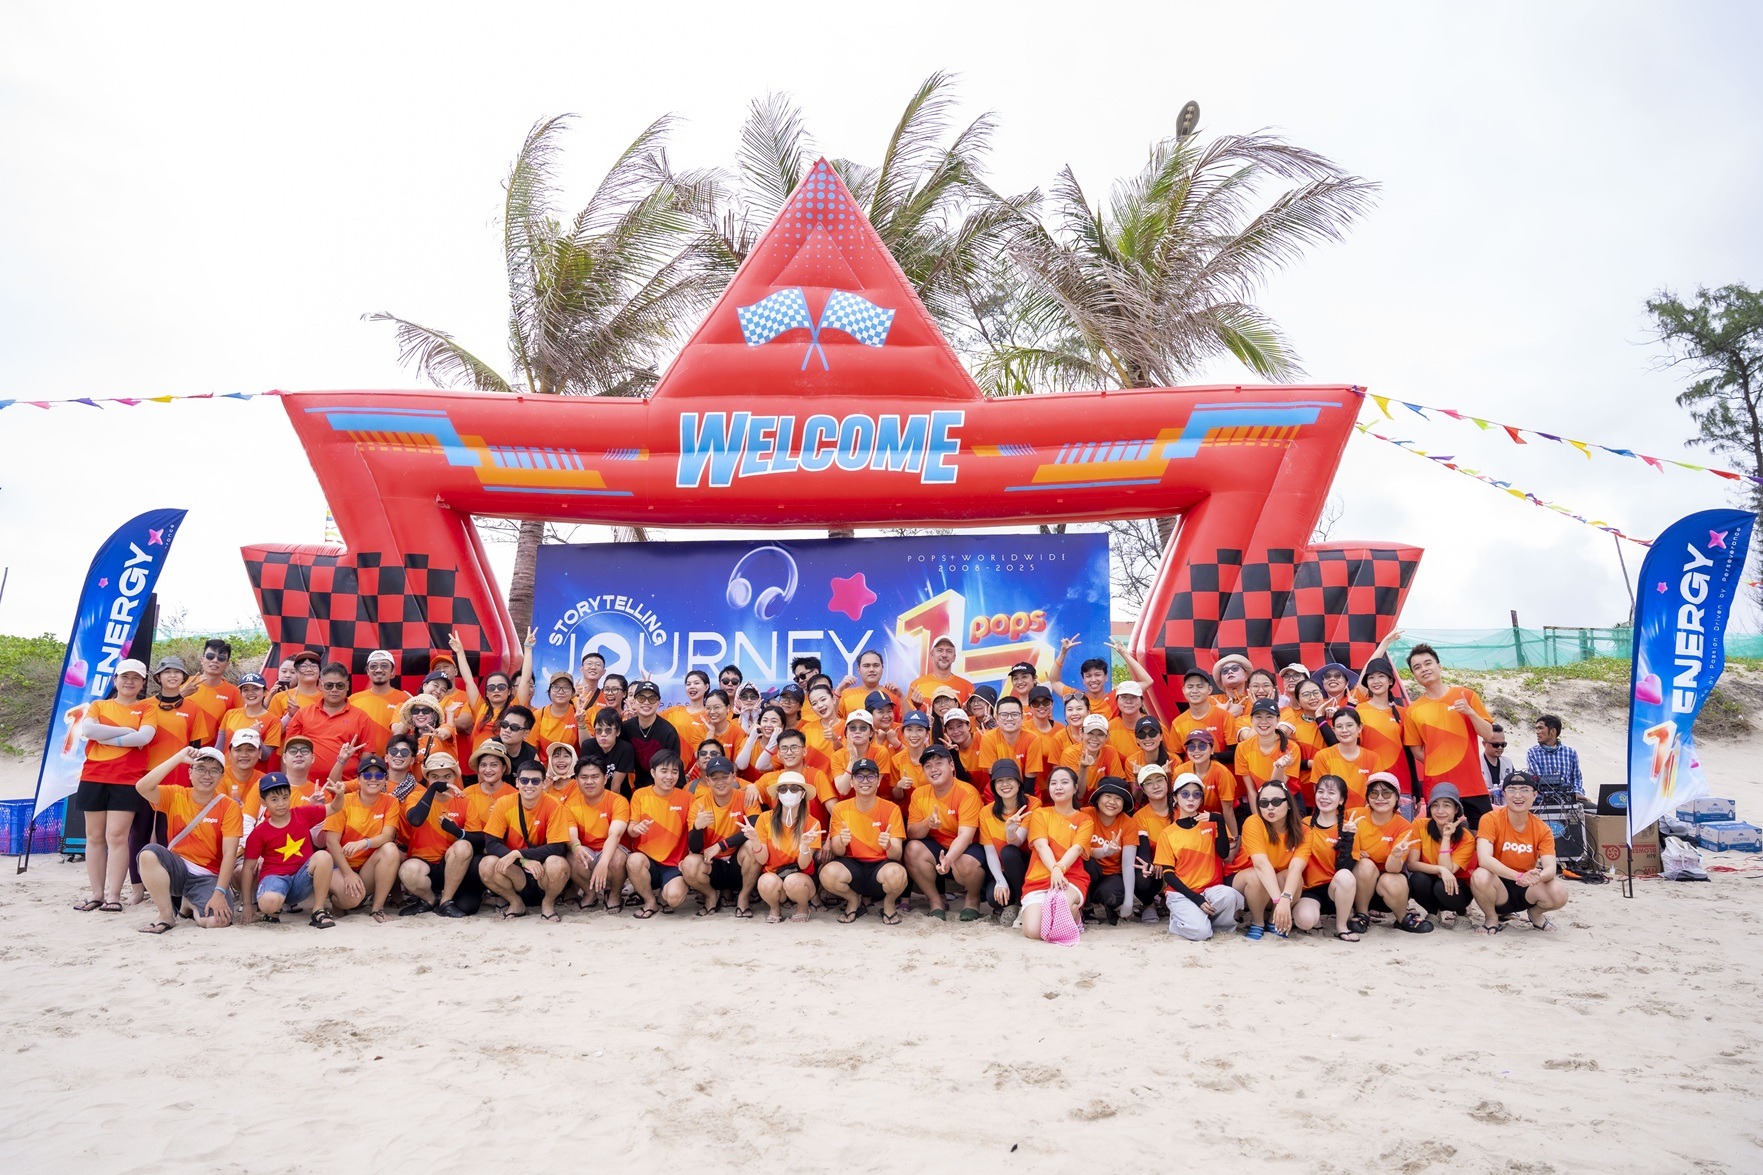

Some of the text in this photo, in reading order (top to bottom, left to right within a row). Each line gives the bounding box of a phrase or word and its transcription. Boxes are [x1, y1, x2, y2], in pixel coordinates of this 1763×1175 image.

[676, 410, 965, 488] WELCOME
[938, 564, 1035, 572] 2008-2025
[961, 553, 1066, 562] WORLDWIDE
[90, 541, 154, 697] ENERGY
[548, 594, 668, 647] STORYTELLING
[969, 609, 1047, 645] pops
[1671, 543, 1714, 714] ENERGY
[202, 817, 218, 825] pops
[1502, 841, 1533, 854] pops
